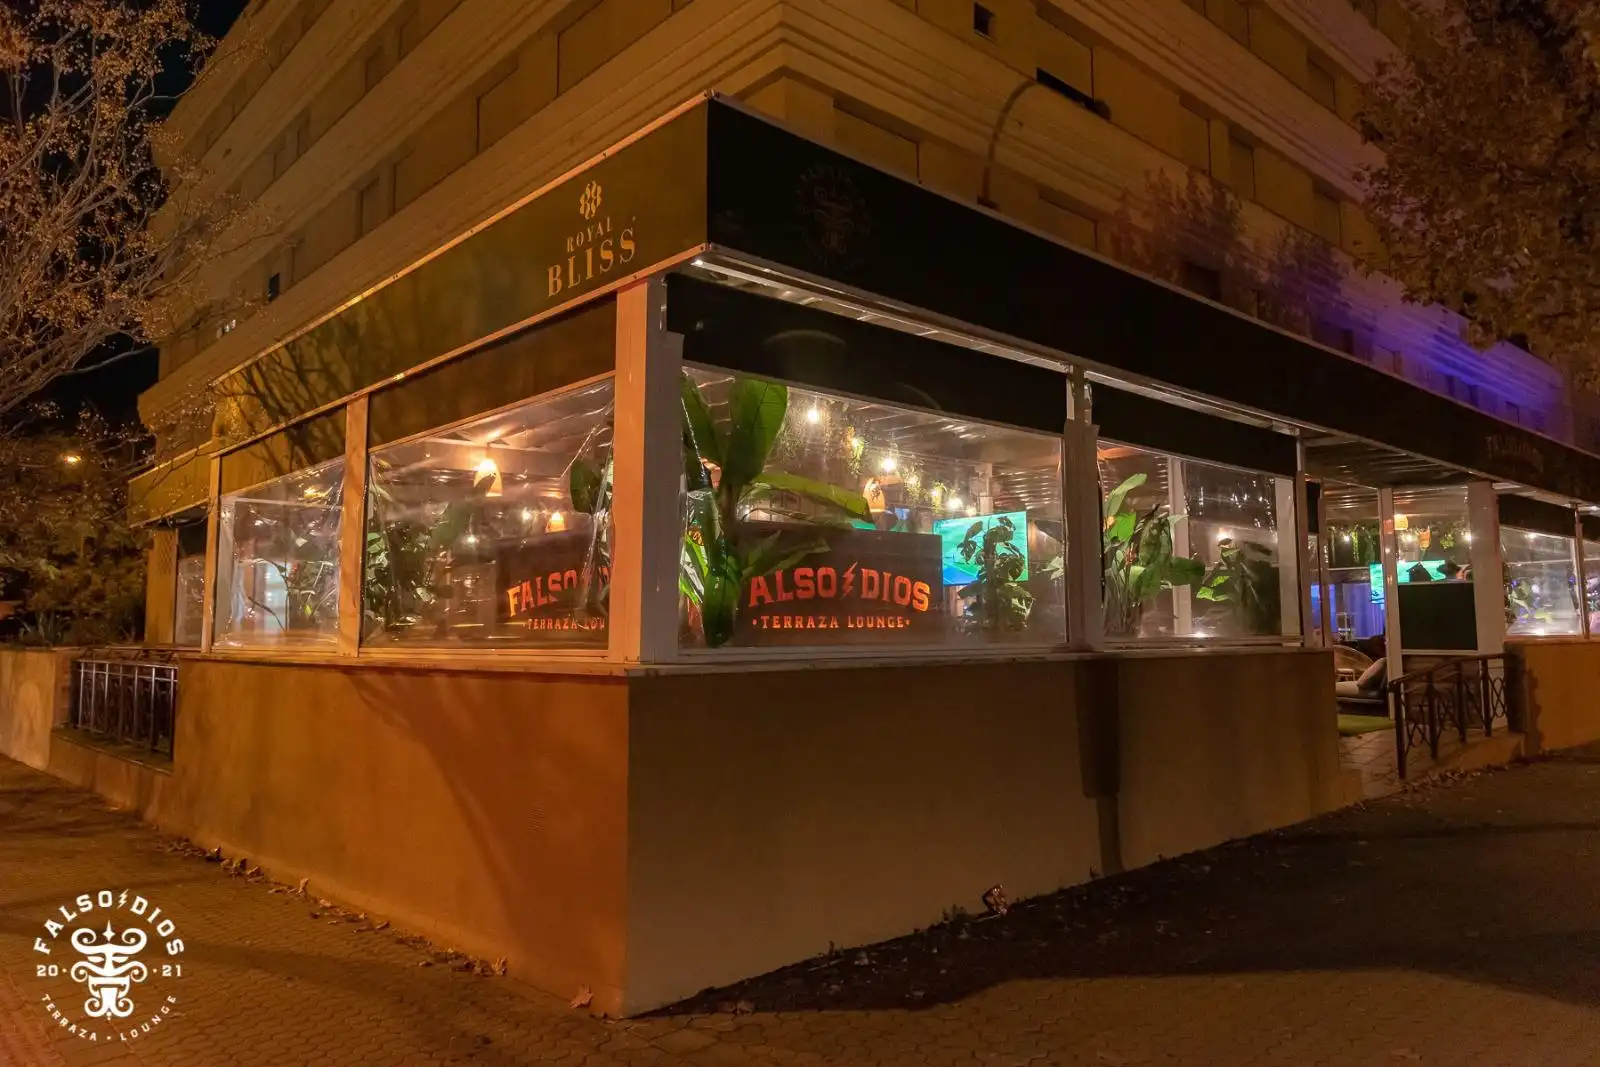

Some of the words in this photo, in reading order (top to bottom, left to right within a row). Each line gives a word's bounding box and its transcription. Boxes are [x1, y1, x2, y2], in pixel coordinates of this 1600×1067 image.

[567, 217, 611, 252] ROYAL
[547, 228, 635, 297] BLISS
[748, 566, 838, 608] ALSO
[861, 568, 931, 612] DIOS
[527, 617, 578, 631] TERRAZA
[760, 616, 839, 629] TERRAZA
[848, 616, 903, 629] LOUNGE
